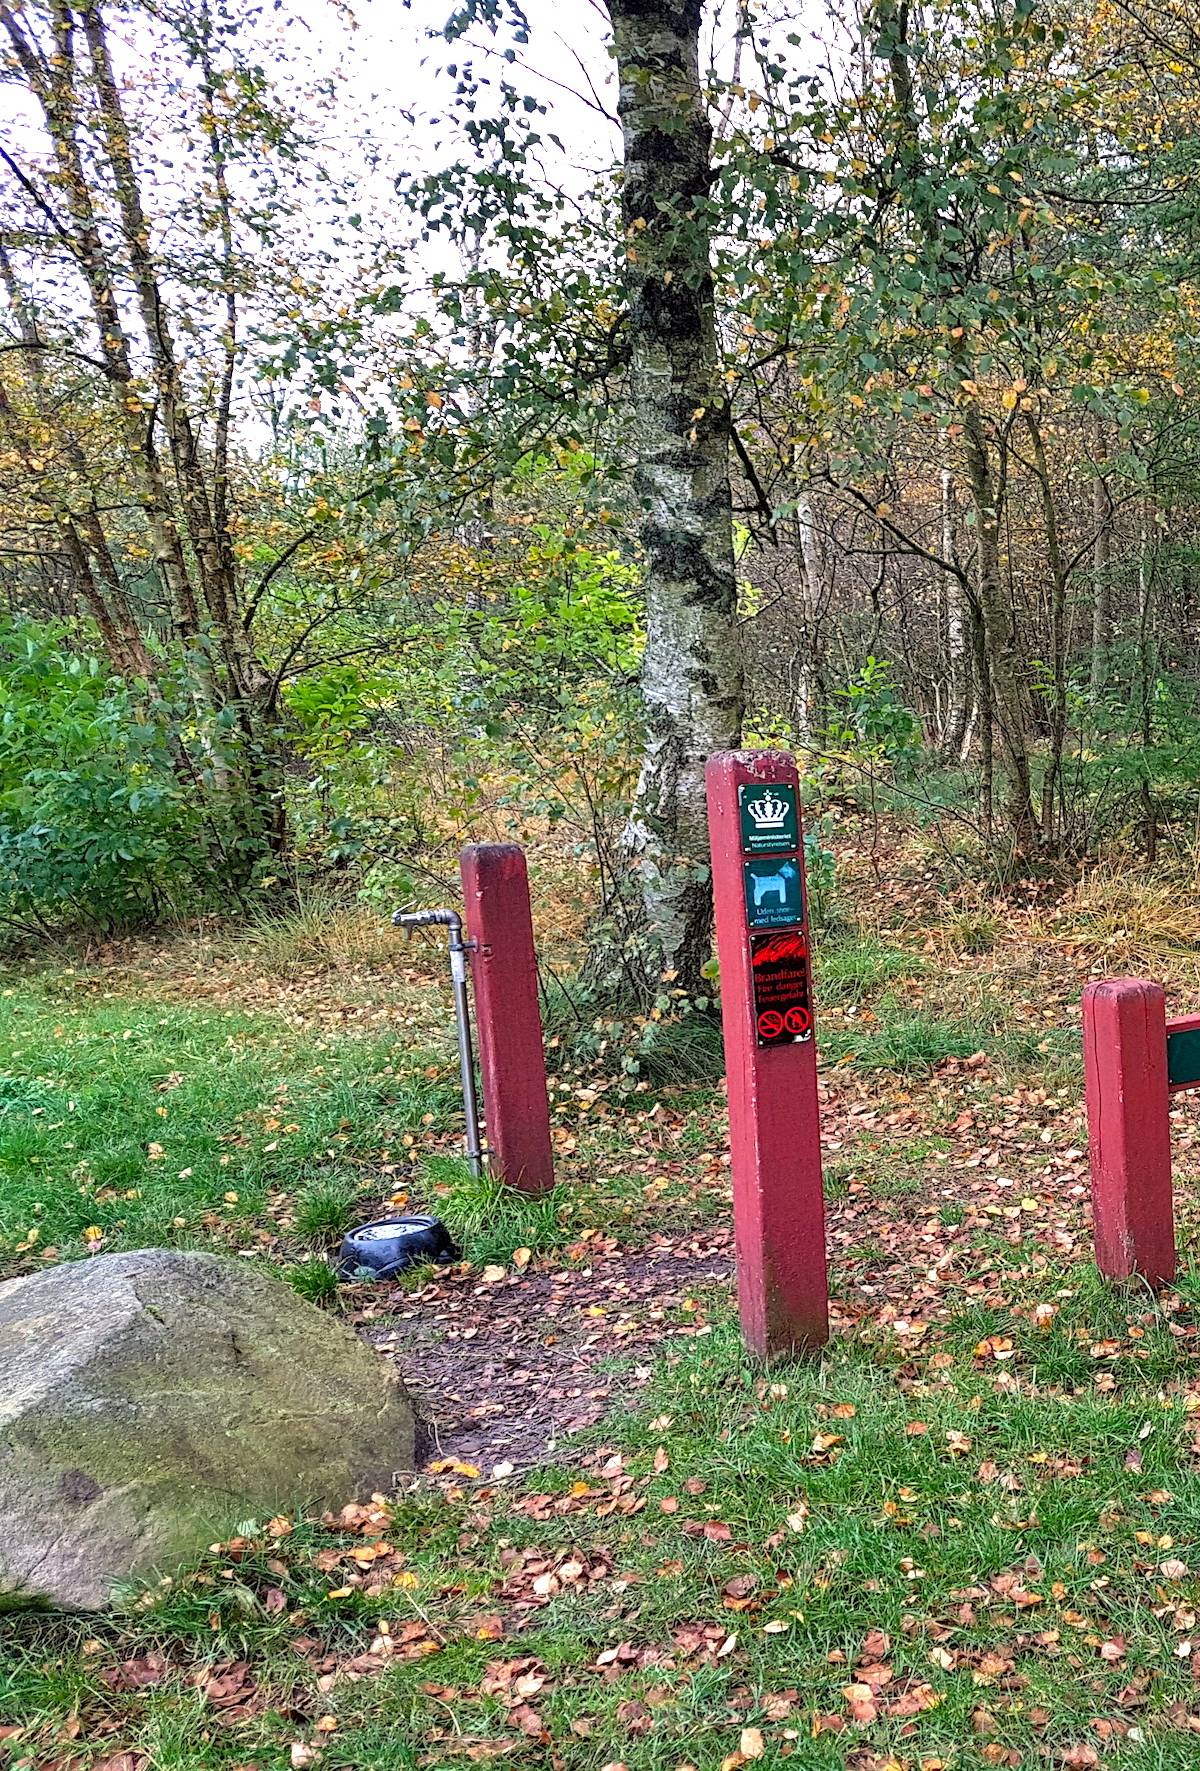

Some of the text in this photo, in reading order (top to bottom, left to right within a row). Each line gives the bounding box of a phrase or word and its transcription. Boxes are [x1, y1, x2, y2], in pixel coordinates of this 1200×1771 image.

[757, 907, 775, 915] Uden
[754, 915, 769, 924] med
[757, 981, 804, 993] Fire danger
